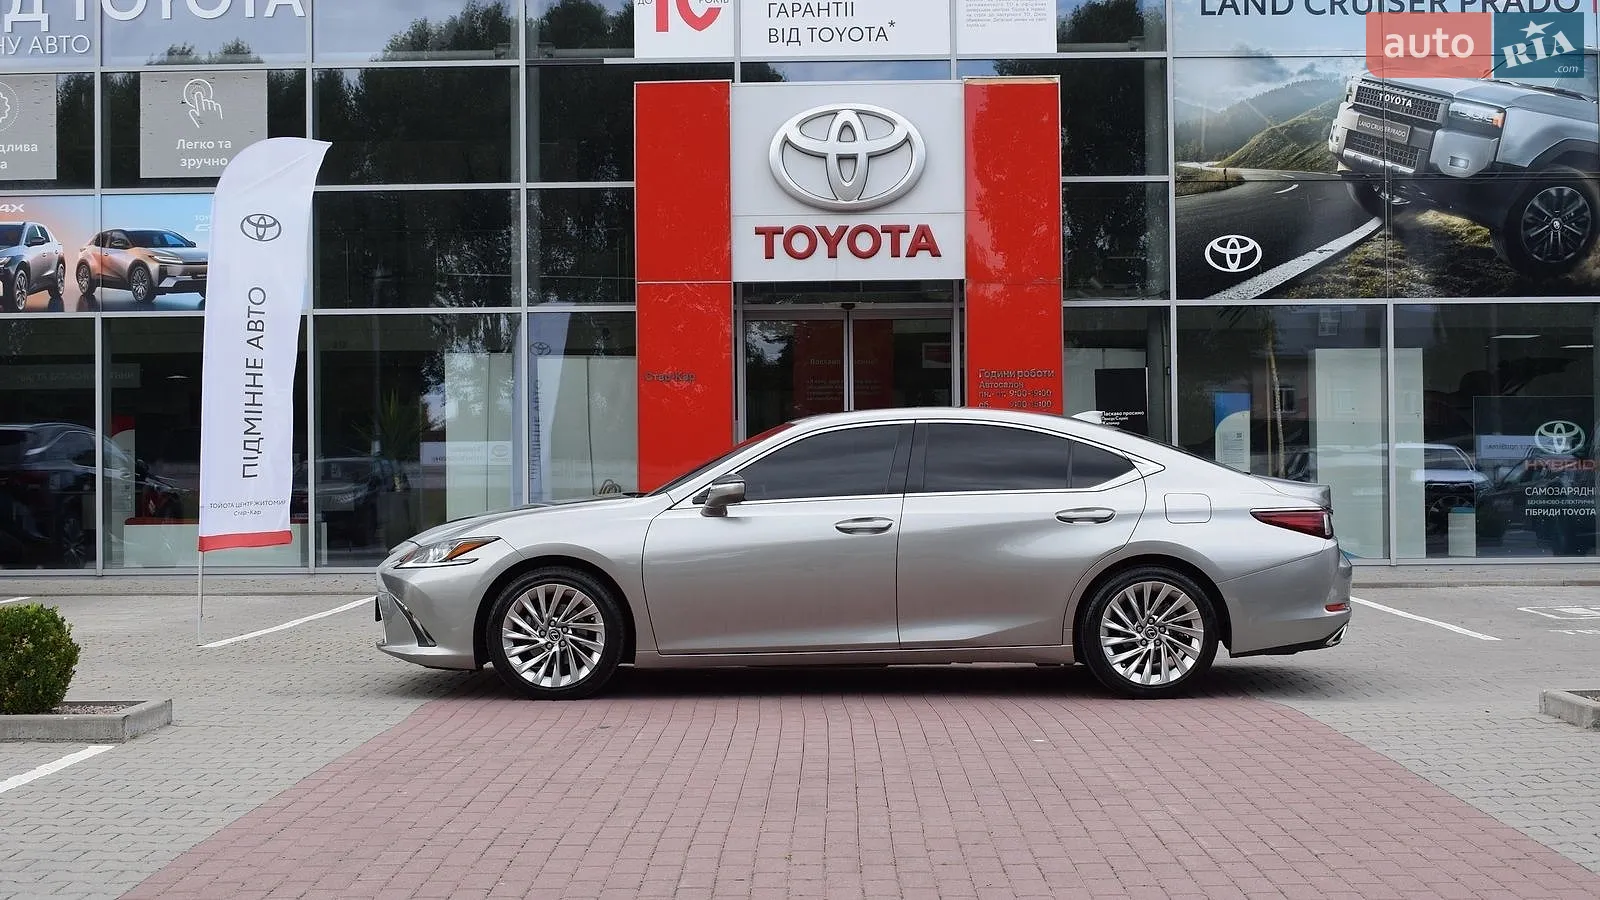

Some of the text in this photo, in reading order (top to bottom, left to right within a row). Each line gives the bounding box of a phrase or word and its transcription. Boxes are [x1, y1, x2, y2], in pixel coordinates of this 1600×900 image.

[768, 27, 801, 46] ВІД
[28, 34, 90, 54] АВТО
[1379, 93, 1412, 107] TOYOTA
[176, 139, 232, 150] Легко та
[180, 158, 228, 169] зручно
[755, 224, 942, 260] TOYOTA
[979, 368, 1055, 379] Години роботи
[243, 286, 266, 479] ПІДМІННЕ АВТО
[1525, 459, 1597, 472] HYBRID
[1525, 508, 1597, 517] ГІБРИДИ TOYOTA
